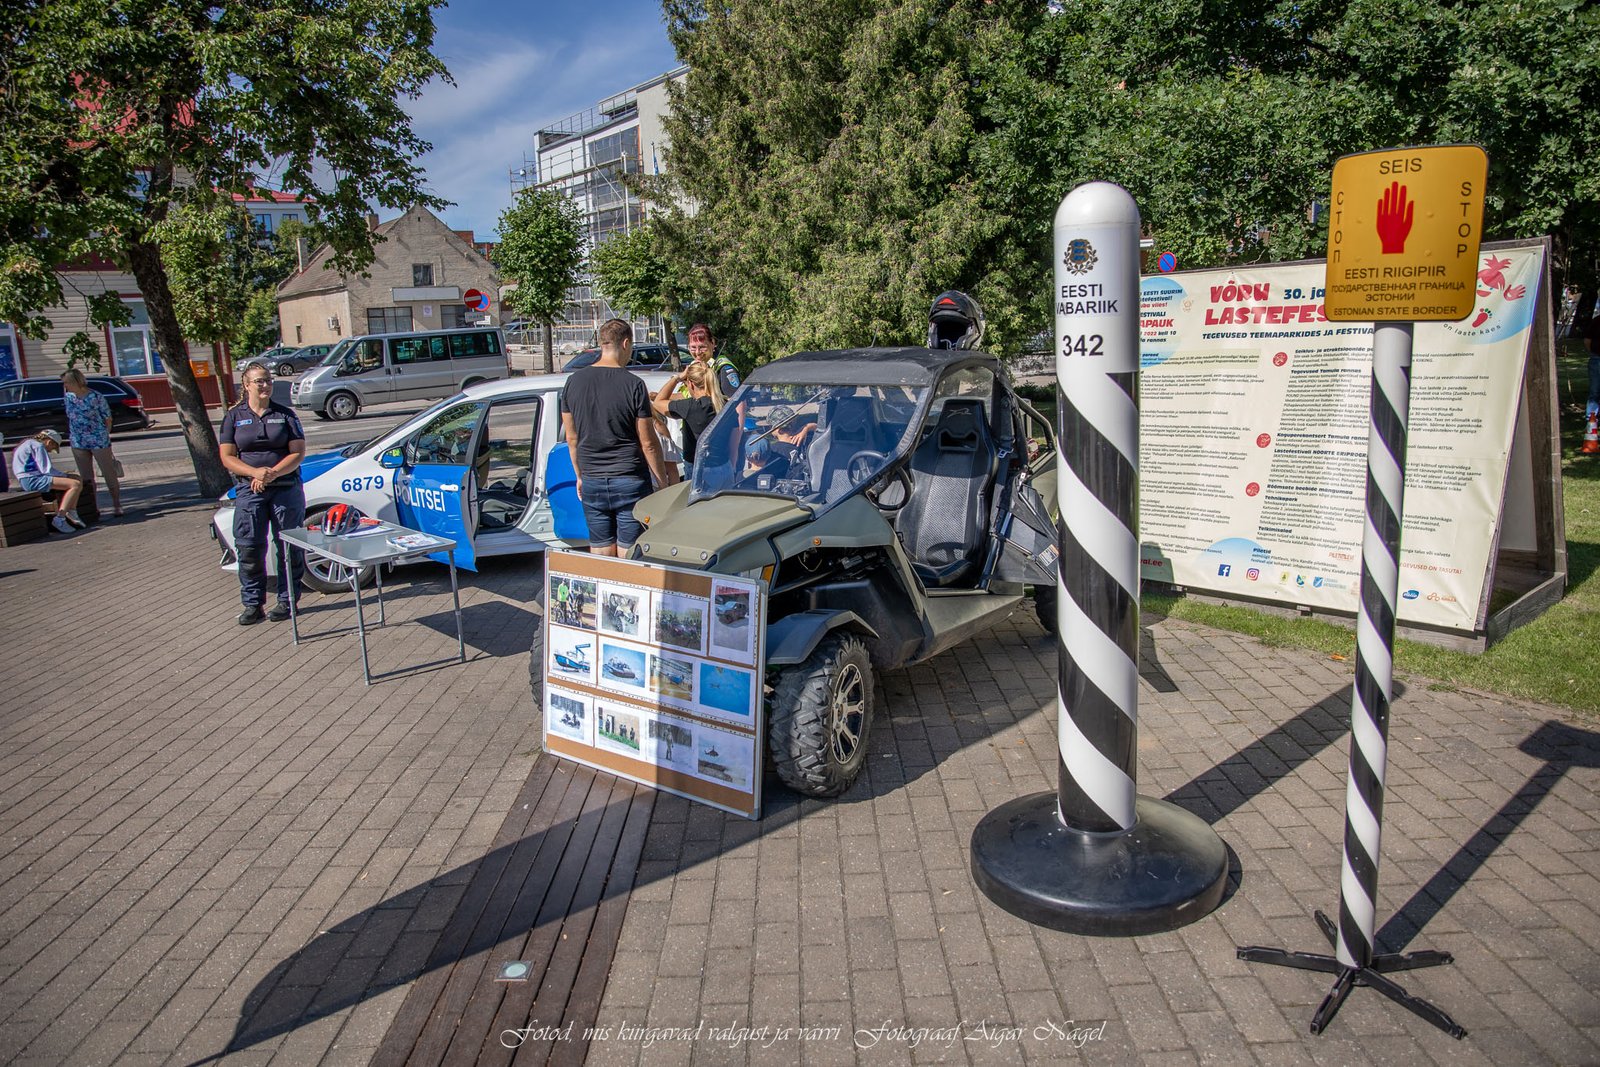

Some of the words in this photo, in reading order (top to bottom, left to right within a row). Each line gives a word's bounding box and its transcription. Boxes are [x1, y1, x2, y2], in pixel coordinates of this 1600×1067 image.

[1379, 157, 1422, 175] SEIS
[1333, 191, 1344, 264] СТОП
[1457, 181, 1472, 259] STOP
[1345, 267, 1379, 280] EESTI
[1382, 265, 1446, 279] RIIGIPIIR
[1061, 284, 1103, 298] EESTI
[1210, 280, 1271, 303] VÕRU
[1283, 288, 1306, 300] 30.
[1332, 282, 1417, 293] ГОСУДАРСТВЕННАЯ
[1418, 282, 1466, 292] ГРАНИЦА
[1365, 292, 1415, 302] ЭСТОНИИ
[1333, 307, 1375, 316] ESTONIAN
[1376, 306, 1410, 316] STATE
[1412, 306, 1457, 315] BORDER
[1250, 330, 1321, 339] TEEMAPARKIDES
[1062, 334, 1104, 357] 342
[341, 475, 385, 493] 6879
[395, 483, 446, 512] POLITSEI
